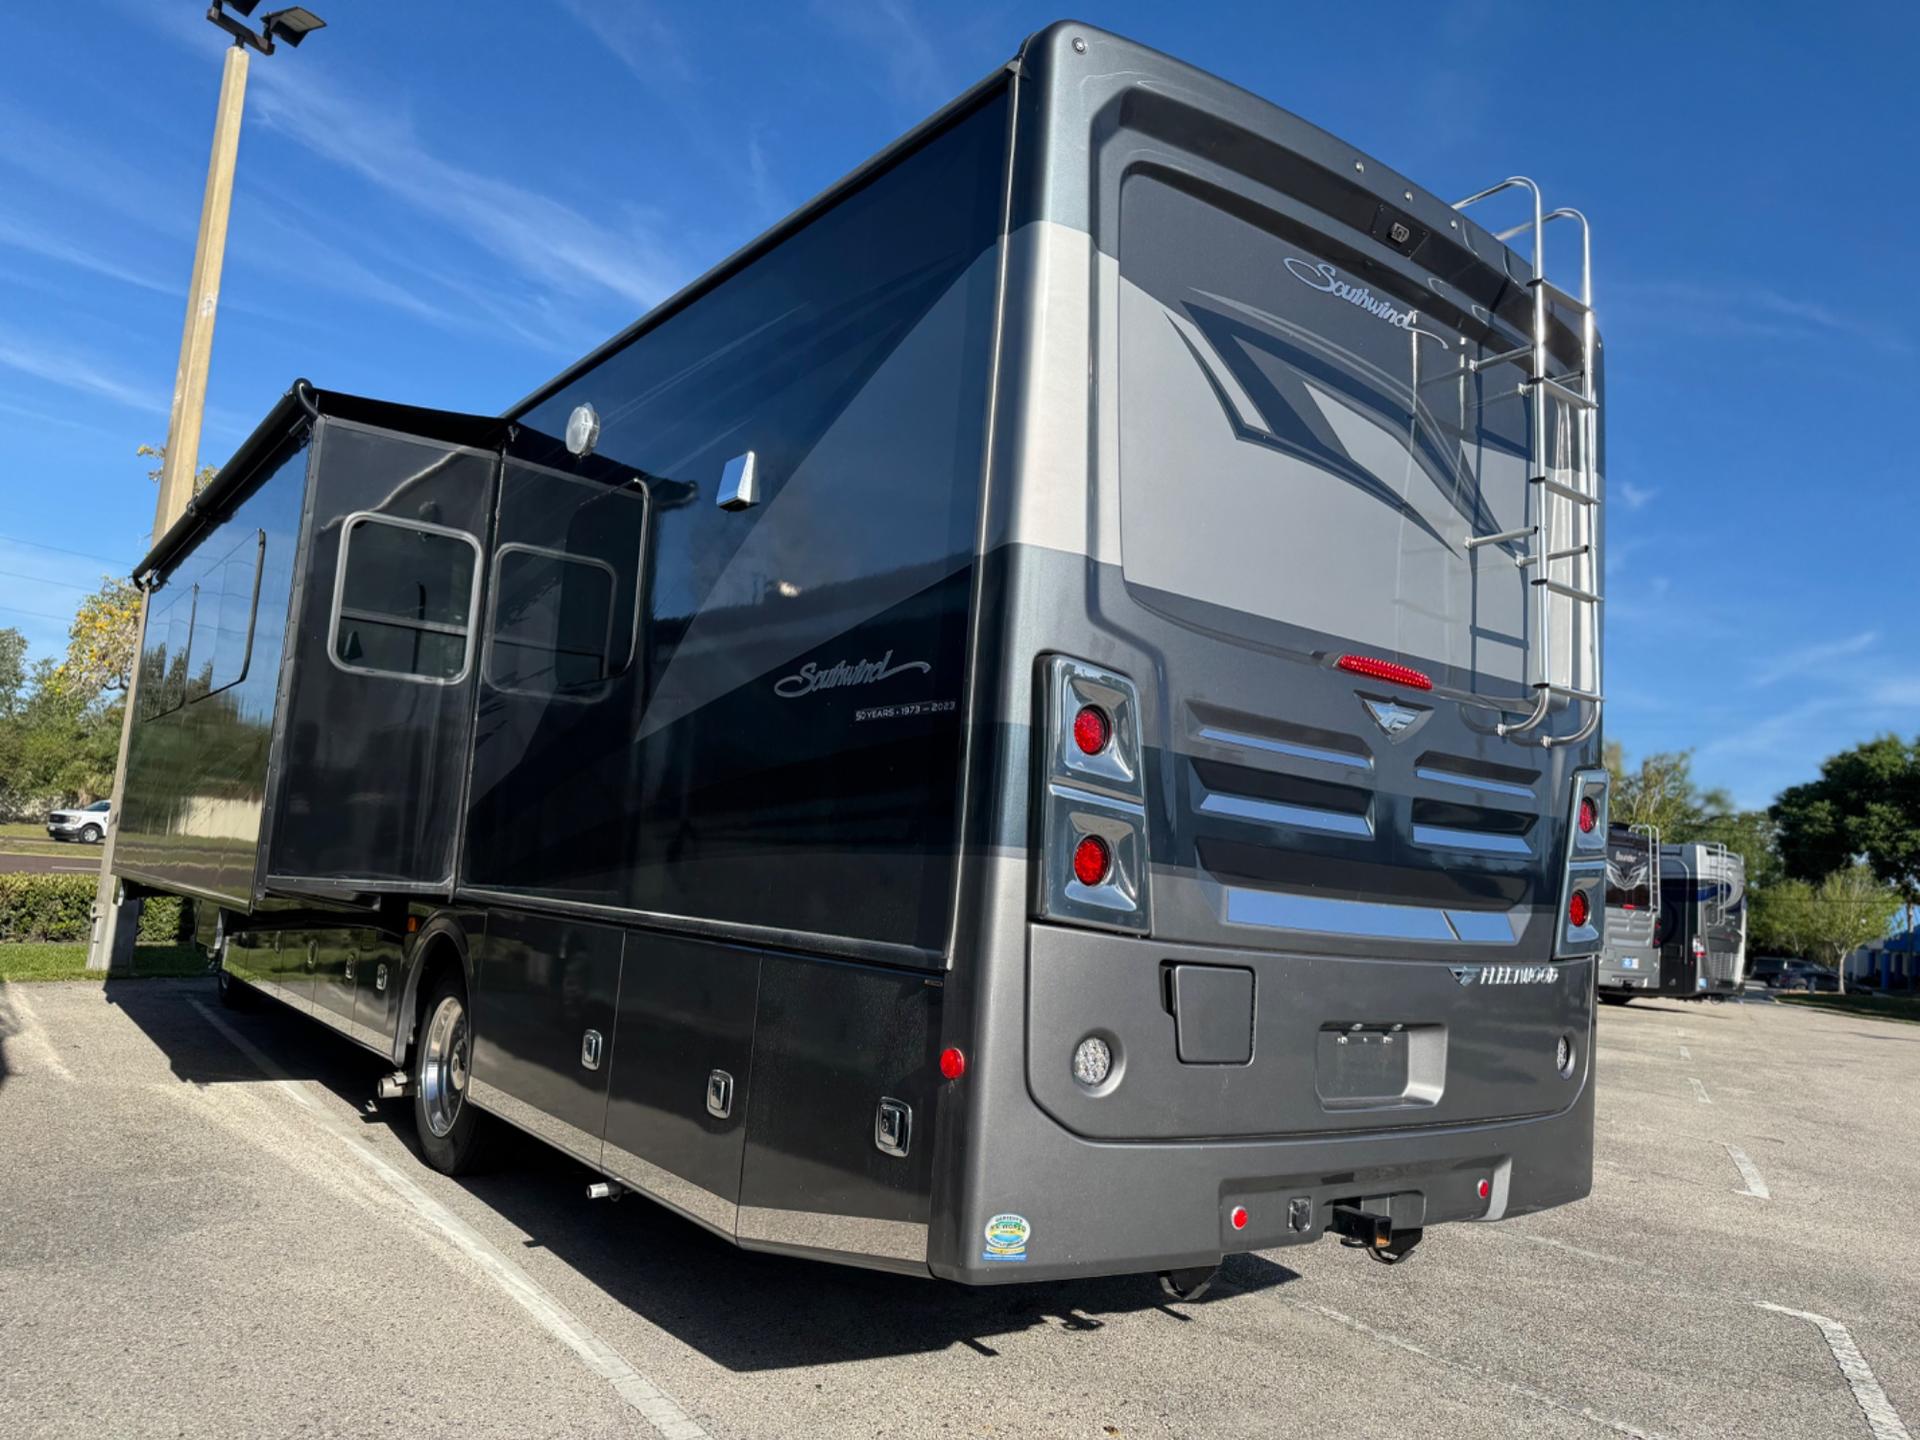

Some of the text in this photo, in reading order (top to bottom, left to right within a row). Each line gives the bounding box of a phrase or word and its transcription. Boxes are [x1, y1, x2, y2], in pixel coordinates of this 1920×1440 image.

[1283, 257, 1449, 350] Southwind
[773, 649, 932, 698] Southwind
[866, 708, 895, 719] YEARS
[901, 705, 921, 715] 1973
